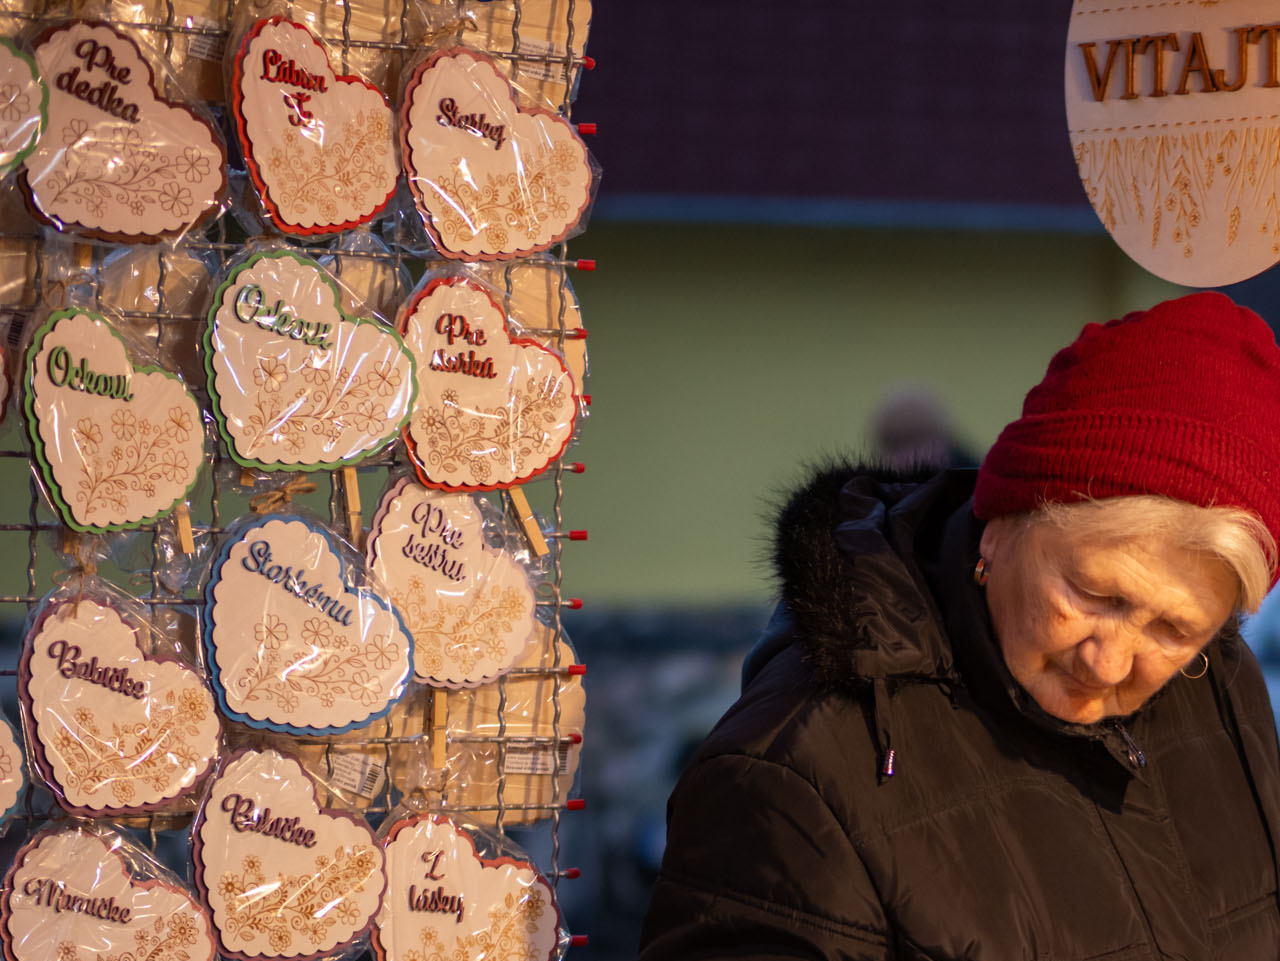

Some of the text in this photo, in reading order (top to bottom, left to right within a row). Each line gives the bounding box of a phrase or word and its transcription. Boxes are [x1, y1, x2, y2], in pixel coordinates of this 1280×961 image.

[75, 39, 132, 85] Pre
[55, 67, 141, 124] dedka
[435, 313, 487, 346] Pre
[411, 502, 464, 549] Pre
[241, 540, 354, 627] Starkému
[47, 640, 146, 700] Babičke
[221, 793, 318, 848] Babičke
[421, 850, 445, 881] Z
